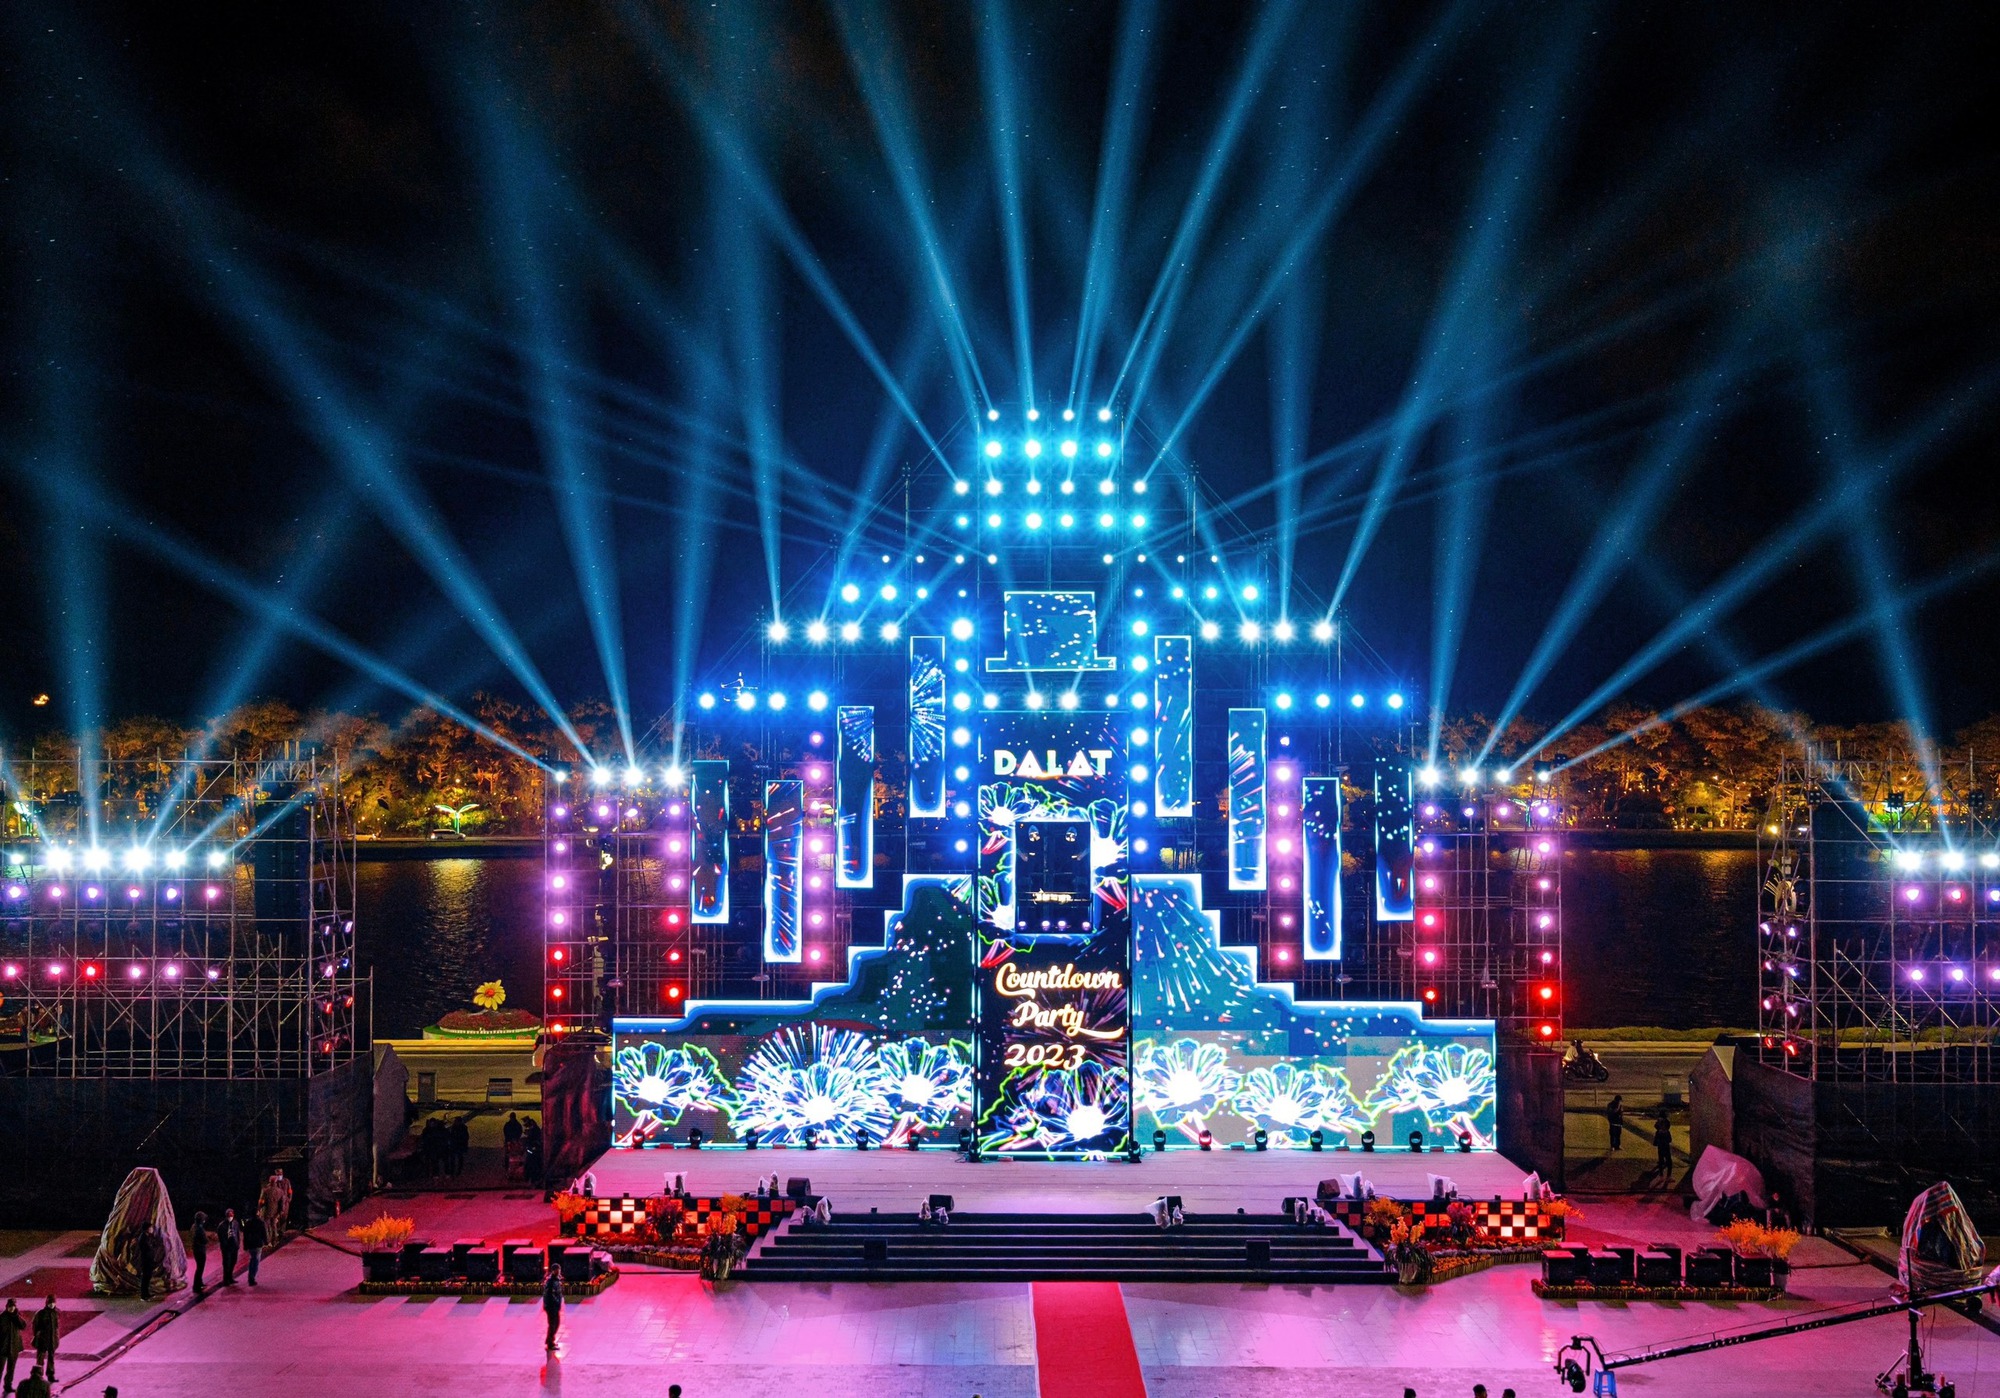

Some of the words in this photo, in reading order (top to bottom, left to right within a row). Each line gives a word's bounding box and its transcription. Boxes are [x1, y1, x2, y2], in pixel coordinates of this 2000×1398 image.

[994, 750, 1112, 776] DALAT
[996, 962, 1122, 999] Countdown
[1012, 1000, 1124, 1039] Party
[1004, 1044, 1086, 1070] 2023
